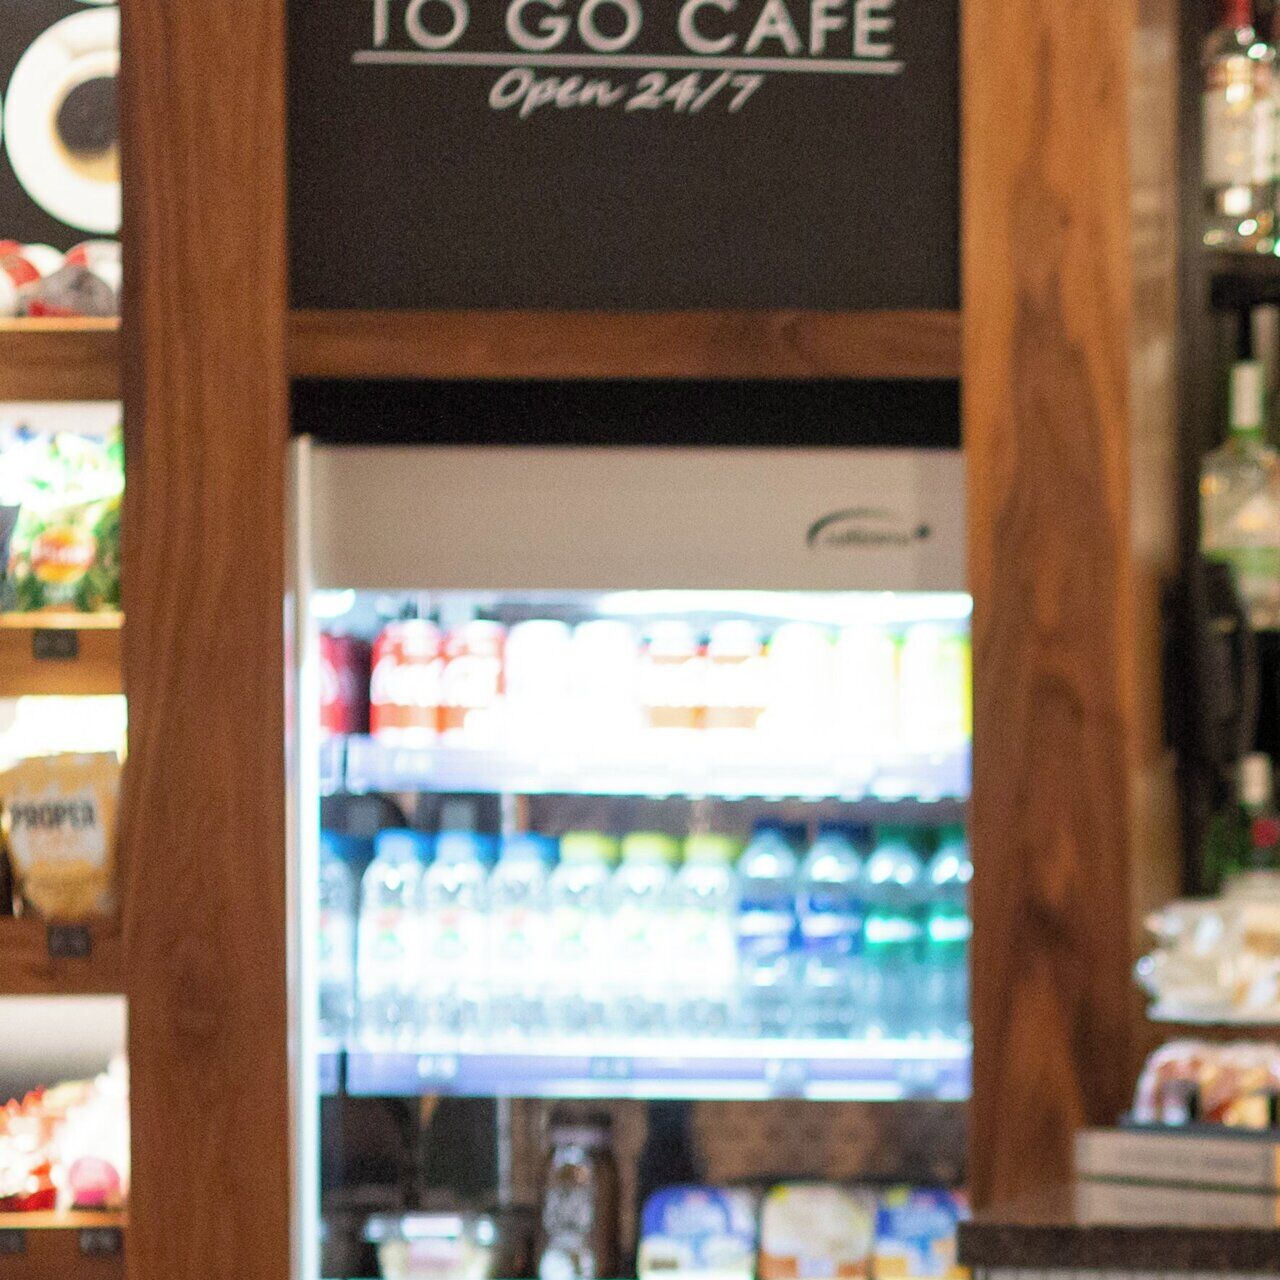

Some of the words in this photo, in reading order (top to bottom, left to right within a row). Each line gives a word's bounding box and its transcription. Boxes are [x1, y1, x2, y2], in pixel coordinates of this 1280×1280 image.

[372, 0, 471, 50] TO
[505, 0, 642, 52] GO
[677, 0, 896, 57] CAFE
[488, 66, 627, 119] Open
[624, 69, 763, 113] 24/7
